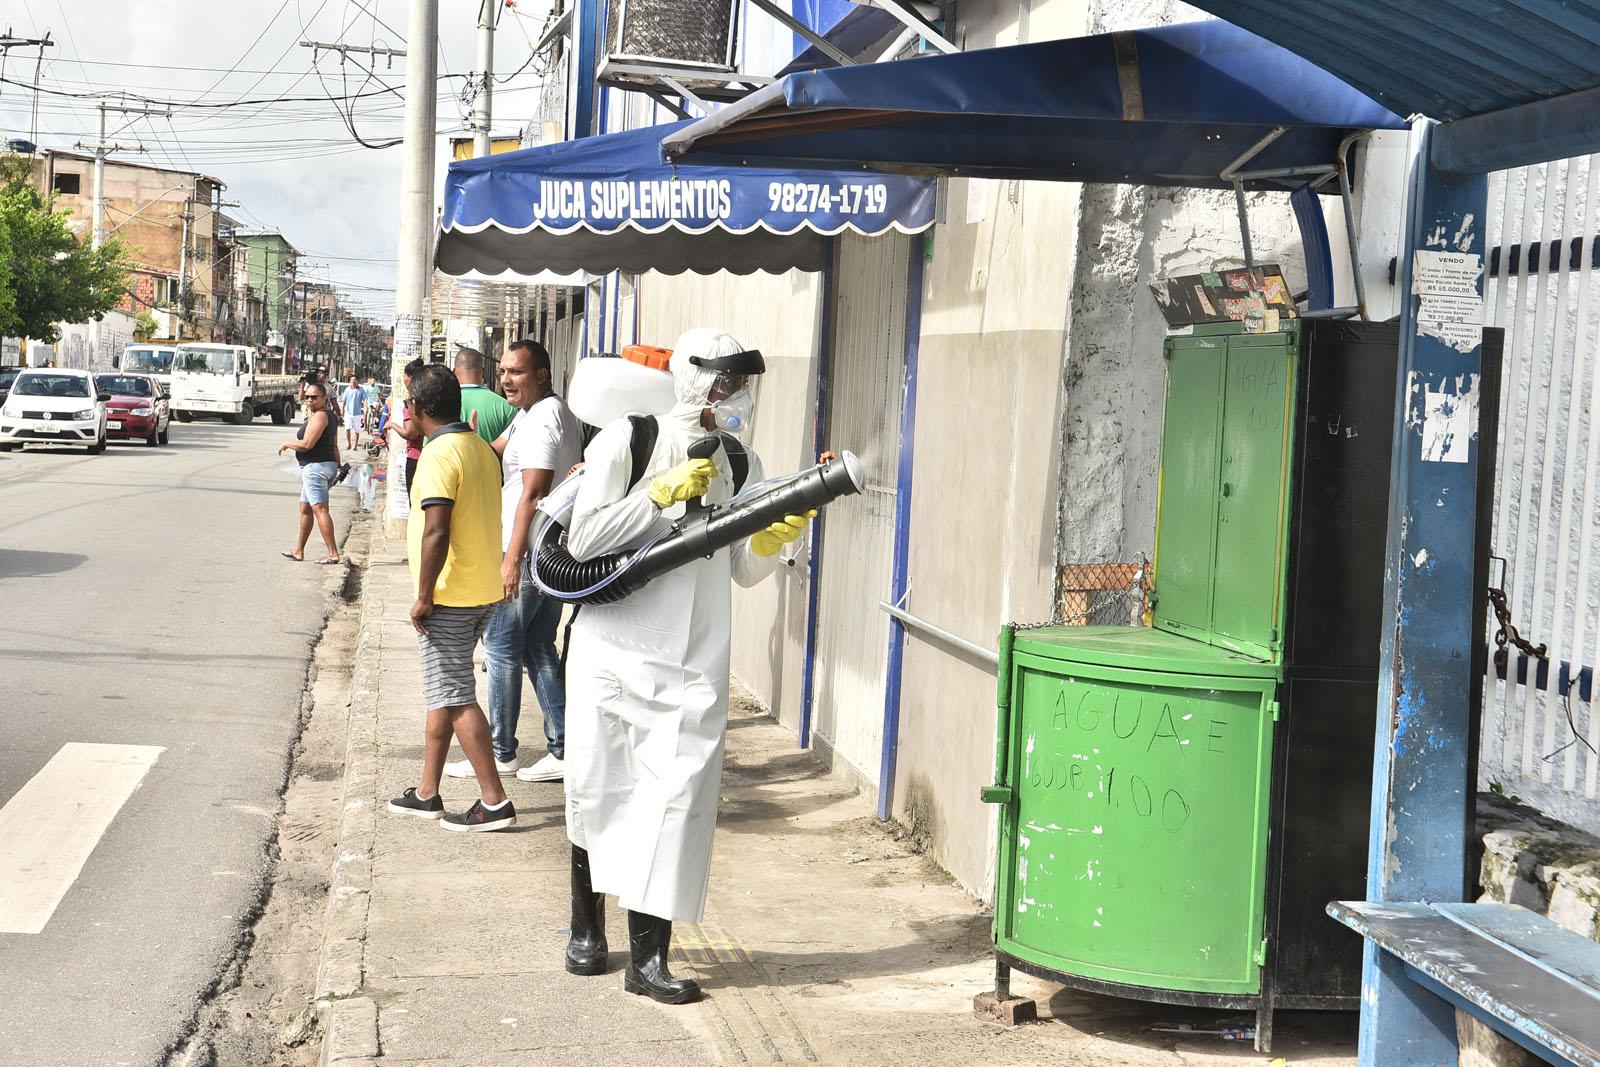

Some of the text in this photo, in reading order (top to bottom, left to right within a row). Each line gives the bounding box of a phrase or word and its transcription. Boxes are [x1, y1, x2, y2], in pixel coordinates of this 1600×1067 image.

[533, 179, 732, 220] JUCA SUPLEMENTOS
[768, 181, 888, 215] 98274-1719
[1053, 689, 1186, 760] AGUA
